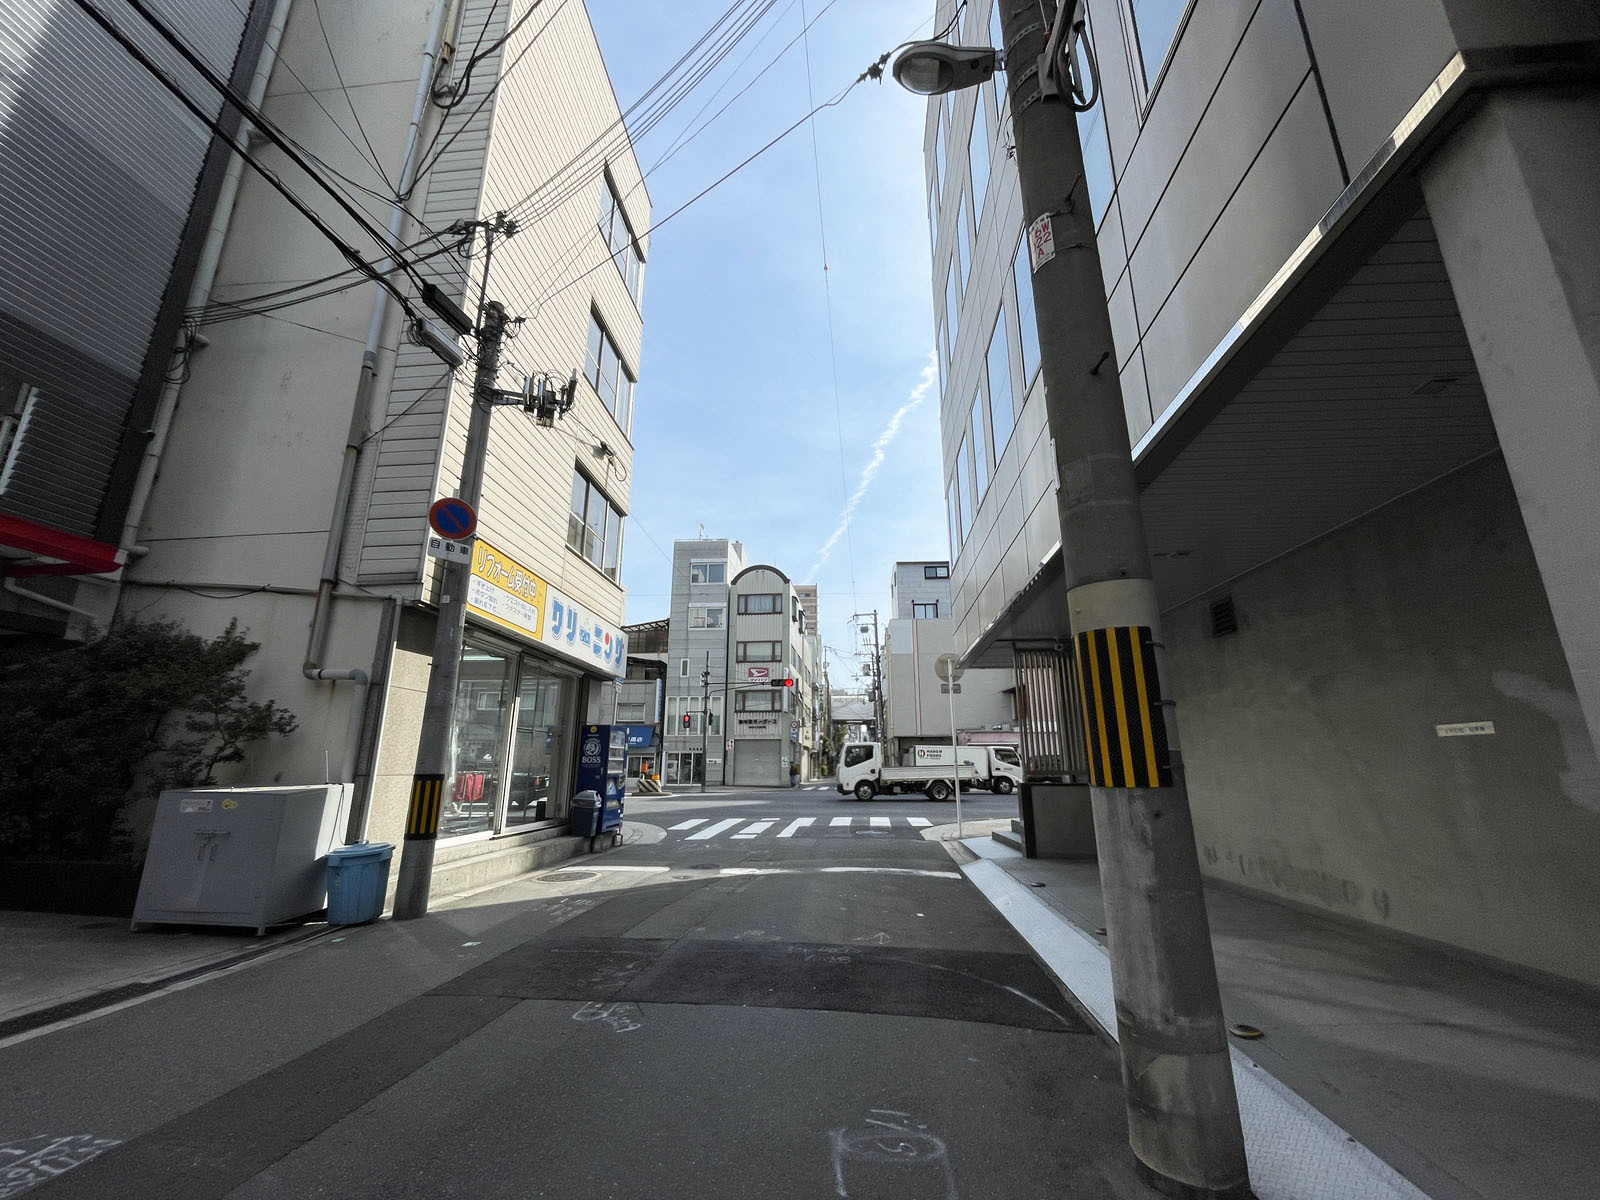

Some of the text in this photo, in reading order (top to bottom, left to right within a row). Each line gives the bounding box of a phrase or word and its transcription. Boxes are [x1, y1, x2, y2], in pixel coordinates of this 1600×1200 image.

[1038, 248, 1045, 259] A
[431, 539, 469, 555] 自動車
[477, 546, 537, 601] リフォーム受付中
[581, 755, 601, 764] BOSS
